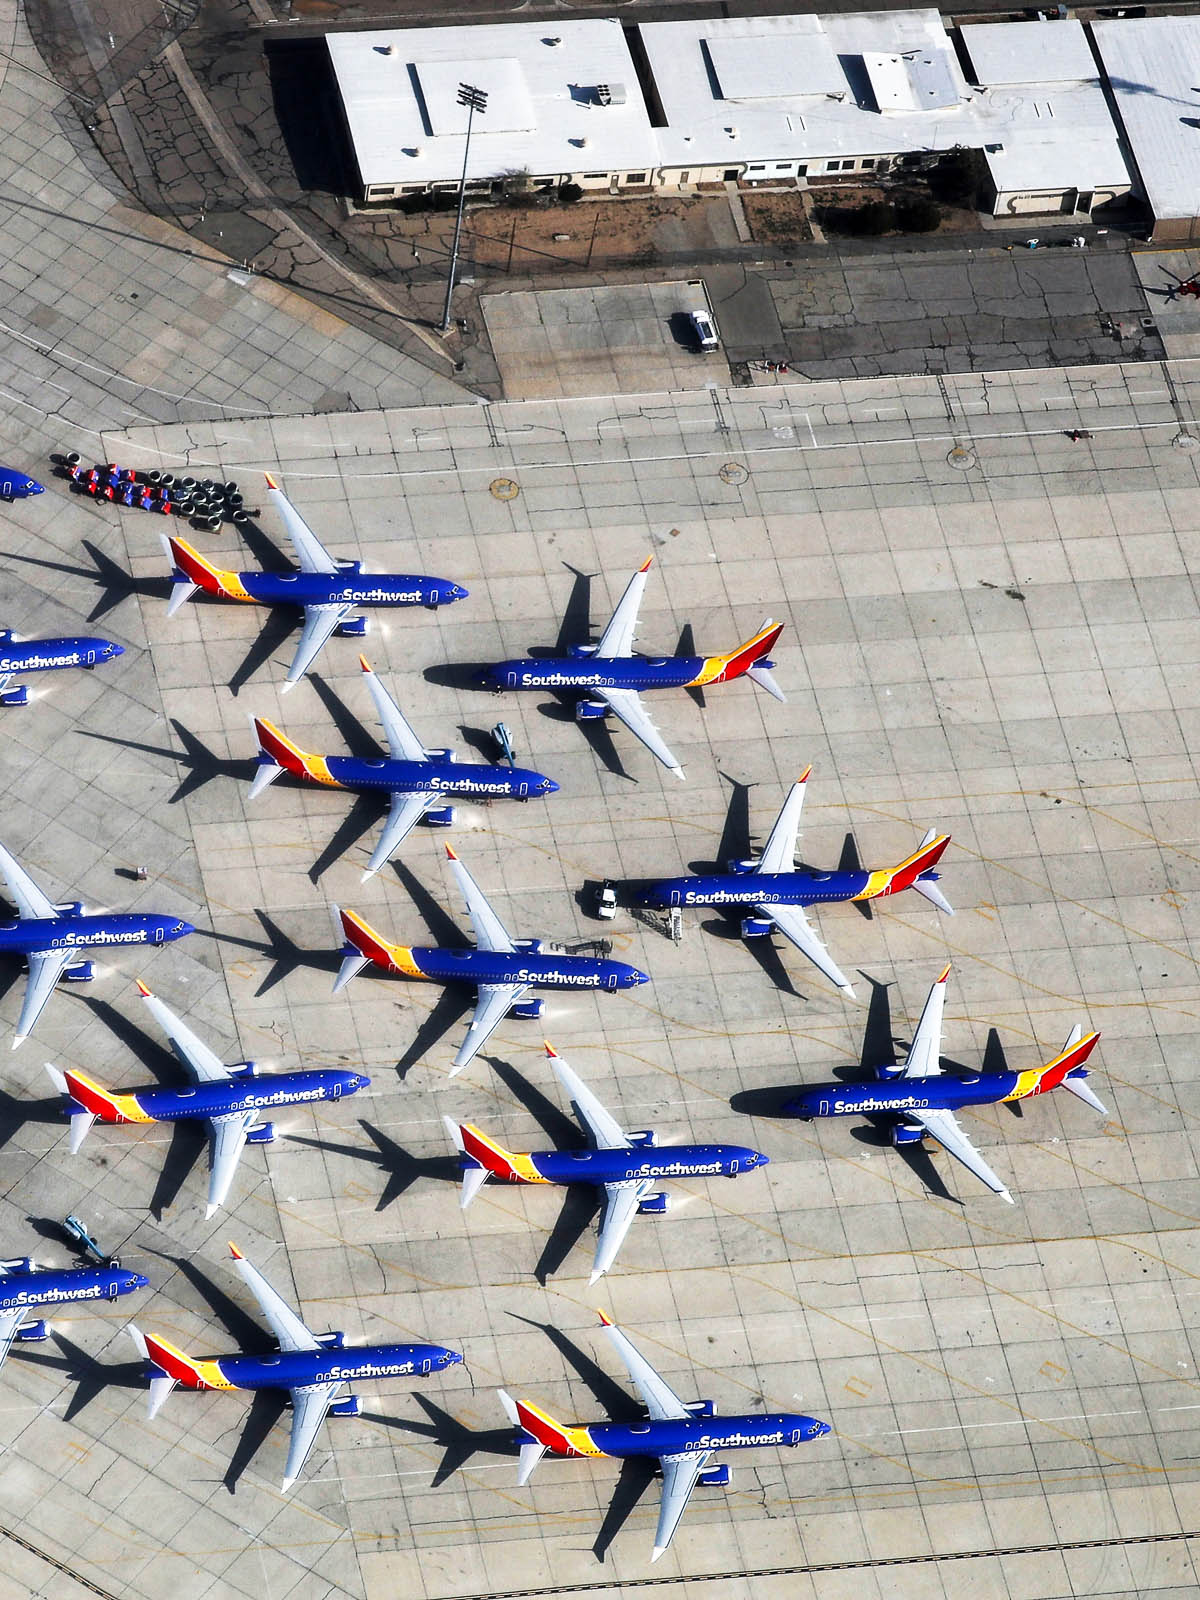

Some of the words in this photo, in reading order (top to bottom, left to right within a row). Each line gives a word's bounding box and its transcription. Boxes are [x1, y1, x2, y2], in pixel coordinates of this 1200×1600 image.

[343, 589, 422, 601] Southwest
[1, 653, 79, 670] Southwest
[522, 673, 601, 686] Southwest
[431, 778, 511, 793] Southwest
[686, 891, 765, 903] Southwest
[66, 930, 147, 945] Southwest
[519, 970, 600, 985] Southwest
[245, 1087, 325, 1108] Southwest
[834, 1097, 915, 1114] Southwest
[640, 1162, 722, 1176] Southwest
[17, 1285, 100, 1304] Southwest
[331, 1362, 413, 1379] Southwest
[700, 1432, 783, 1448] Southwest
